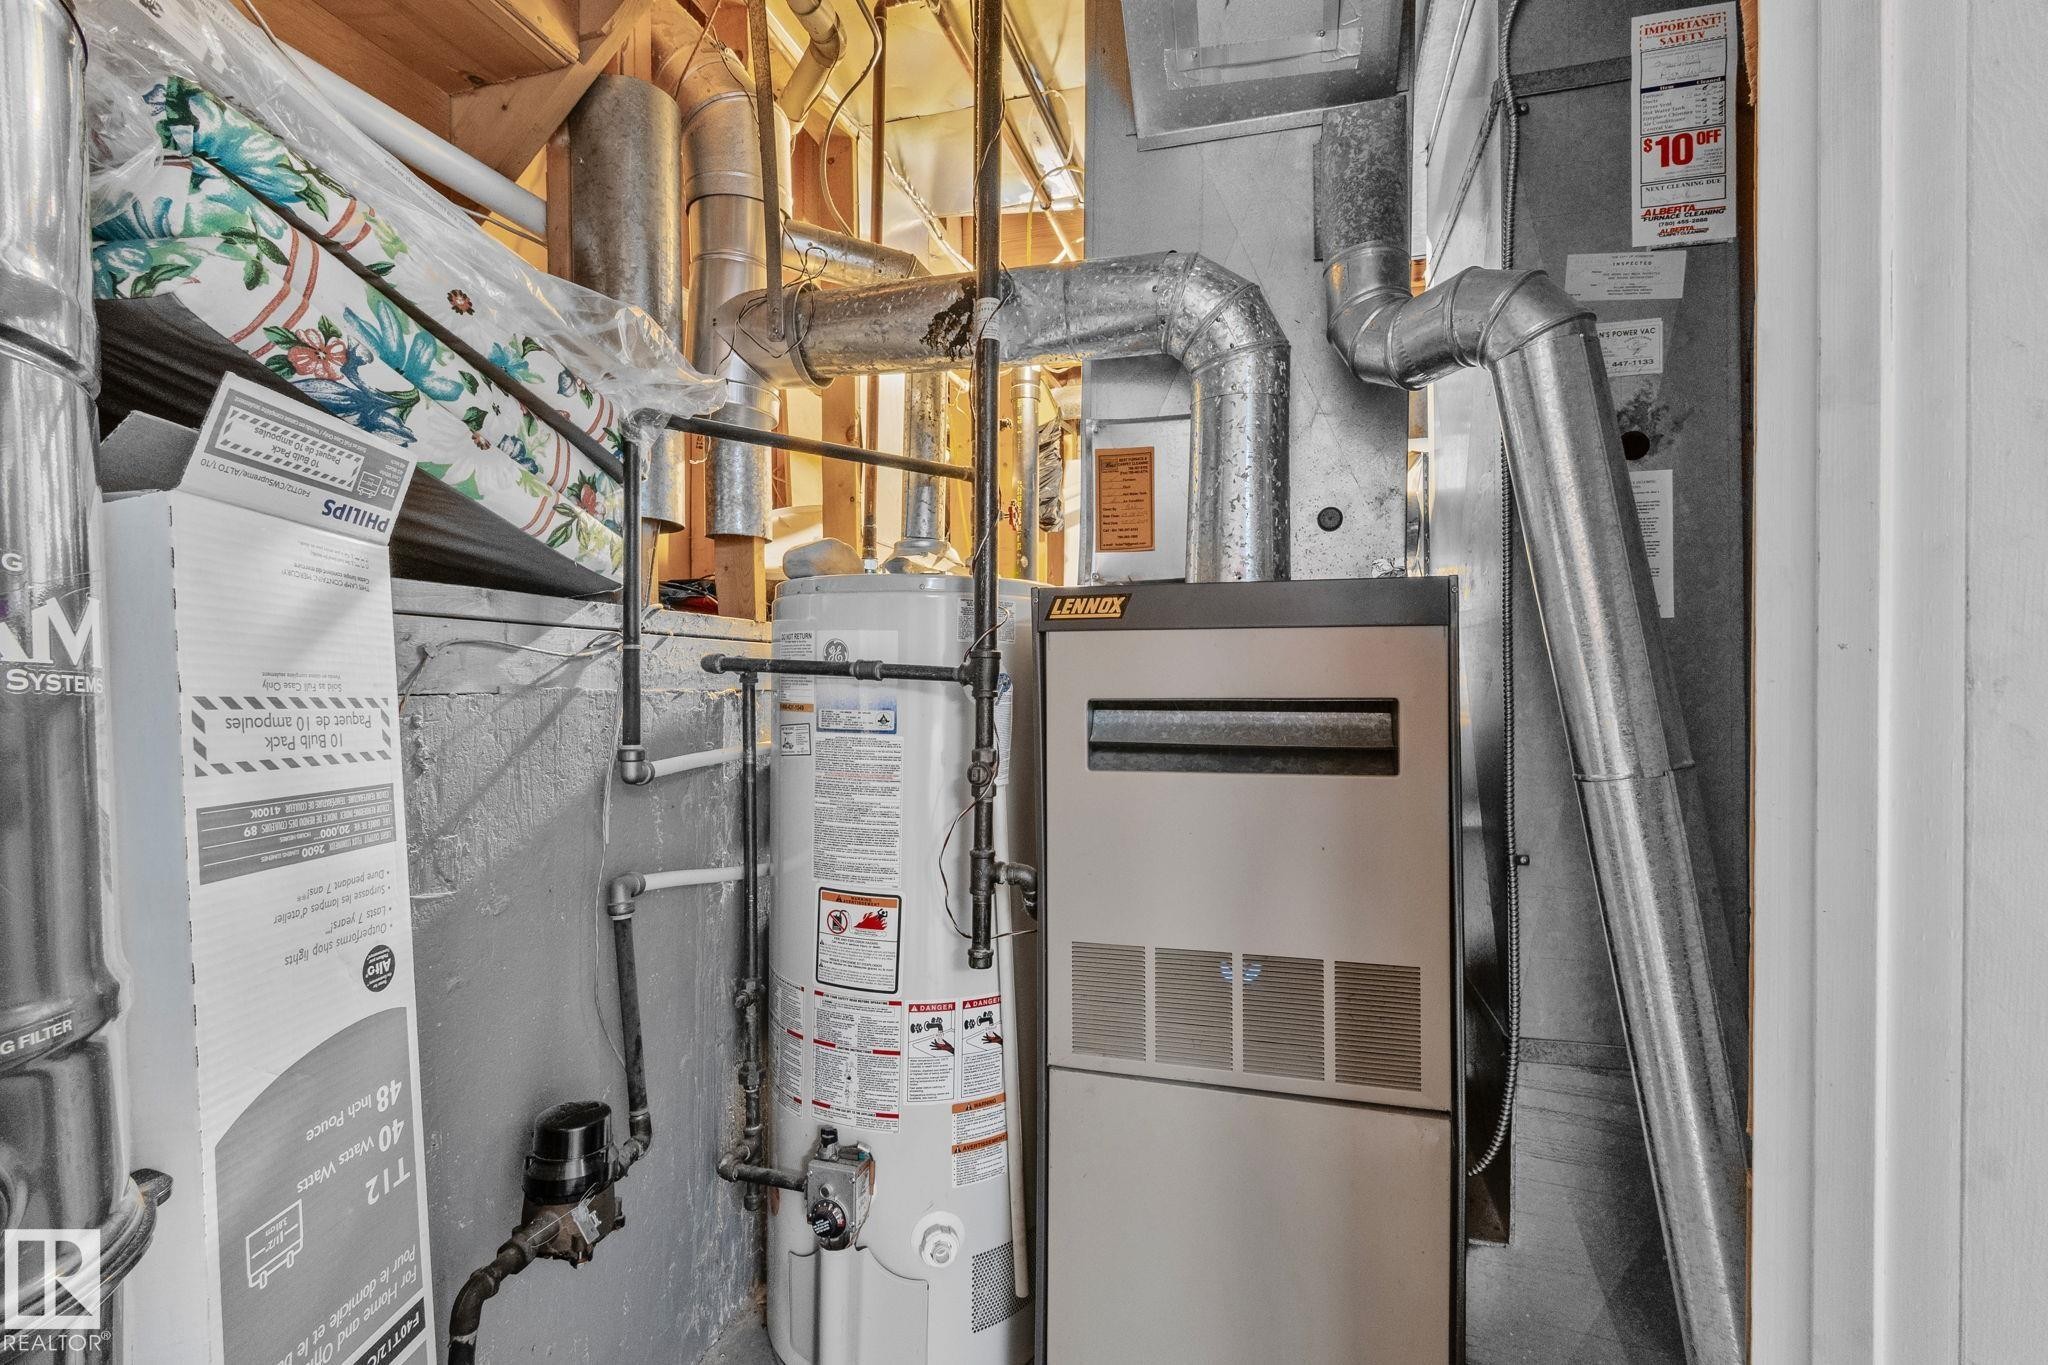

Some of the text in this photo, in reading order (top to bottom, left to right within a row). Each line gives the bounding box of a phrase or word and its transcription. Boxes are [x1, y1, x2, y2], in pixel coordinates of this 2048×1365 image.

[1644, 16, 1721, 35] IMPORTANT!
[1660, 31, 1706, 45] SAFETY
[1696, 129, 1722, 145] OFF
[1646, 184, 1664, 192] NEXT
[1666, 180, 1704, 190] CLEANING
[1642, 204, 1696, 216] ALBERTA
[1642, 208, 1724, 222] FURNACE CLEANING
[1660, 225, 1696, 234] ALBERTA
[1612, 329, 1638, 337] POWER
[254, 426, 340, 465] Paquet de 10 ampoules
[271, 444, 320, 468] 10 Bulb Pack
[381, 485, 395, 498] T12
[322, 500, 390, 533] PHILIPS
[1050, 597, 1126, 615] LENNOX
[794, 632, 812, 640] RETURN
[6, 668, 104, 694] SYSTEMS
[262, 679, 280, 692] Only
[284, 682, 301, 691] Case
[225, 711, 372, 734] Paquet de 10 ampoules
[264, 734, 343, 752] 10 Bulb Pack
[250, 806, 281, 819] 4100K
[244, 826, 258, 838] 89
[302, 844, 324, 857] 2600
[335, 870, 365, 891] pendant
[367, 869, 384, 881] Dure
[326, 884, 332, 894] 7
[273, 885, 386, 925] Surpasse les lampes d'atelier
[366, 906, 386, 918] Lasts
[358, 913, 363, 924] 7
[284, 922, 387, 966] Outperforms shop lights
[18, 1020, 72, 1049] FILTER
[306, 1078, 402, 1143] 48 Inch Pouce
[974, 1098, 997, 1107] WARNING
[963, 1135, 1006, 1150] AVERTISSEMENT
[296, 1118, 405, 1194] 40 Watts Watts
[365, 1157, 411, 1206] T12
[392, 1244, 416, 1273] Pour
[381, 1266, 390, 1283] le
[401, 1264, 416, 1288] For
[329, 1278, 376, 1328] domicile
[363, 1282, 397, 1321] Home
[312, 1324, 325, 1345] et
[337, 1317, 360, 1351] and
[297, 1337, 309, 1356] le
